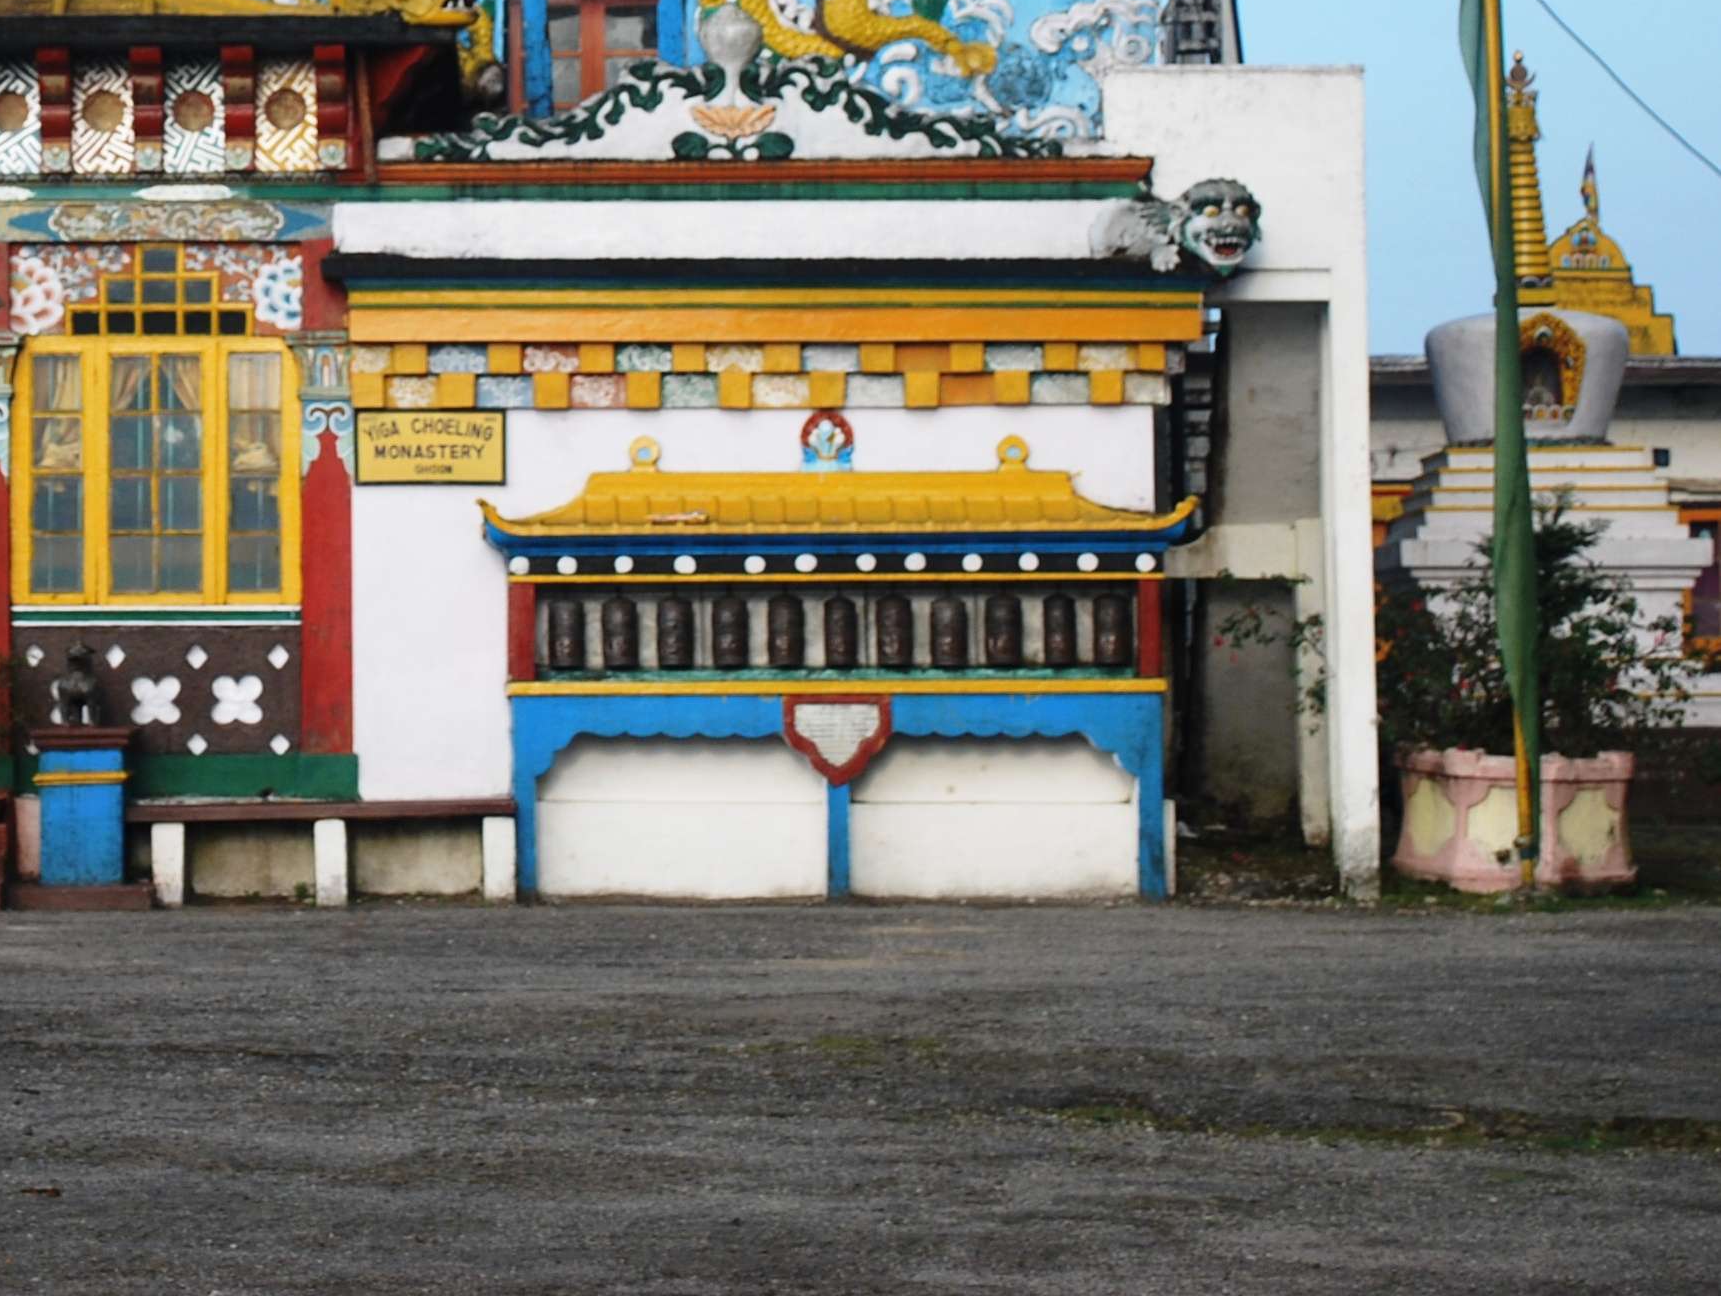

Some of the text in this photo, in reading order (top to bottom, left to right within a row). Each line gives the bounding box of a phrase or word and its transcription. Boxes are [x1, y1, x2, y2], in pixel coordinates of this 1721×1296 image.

[363, 417, 495, 442] YIGA CHOELING
[374, 444, 485, 460] MONASTERY
